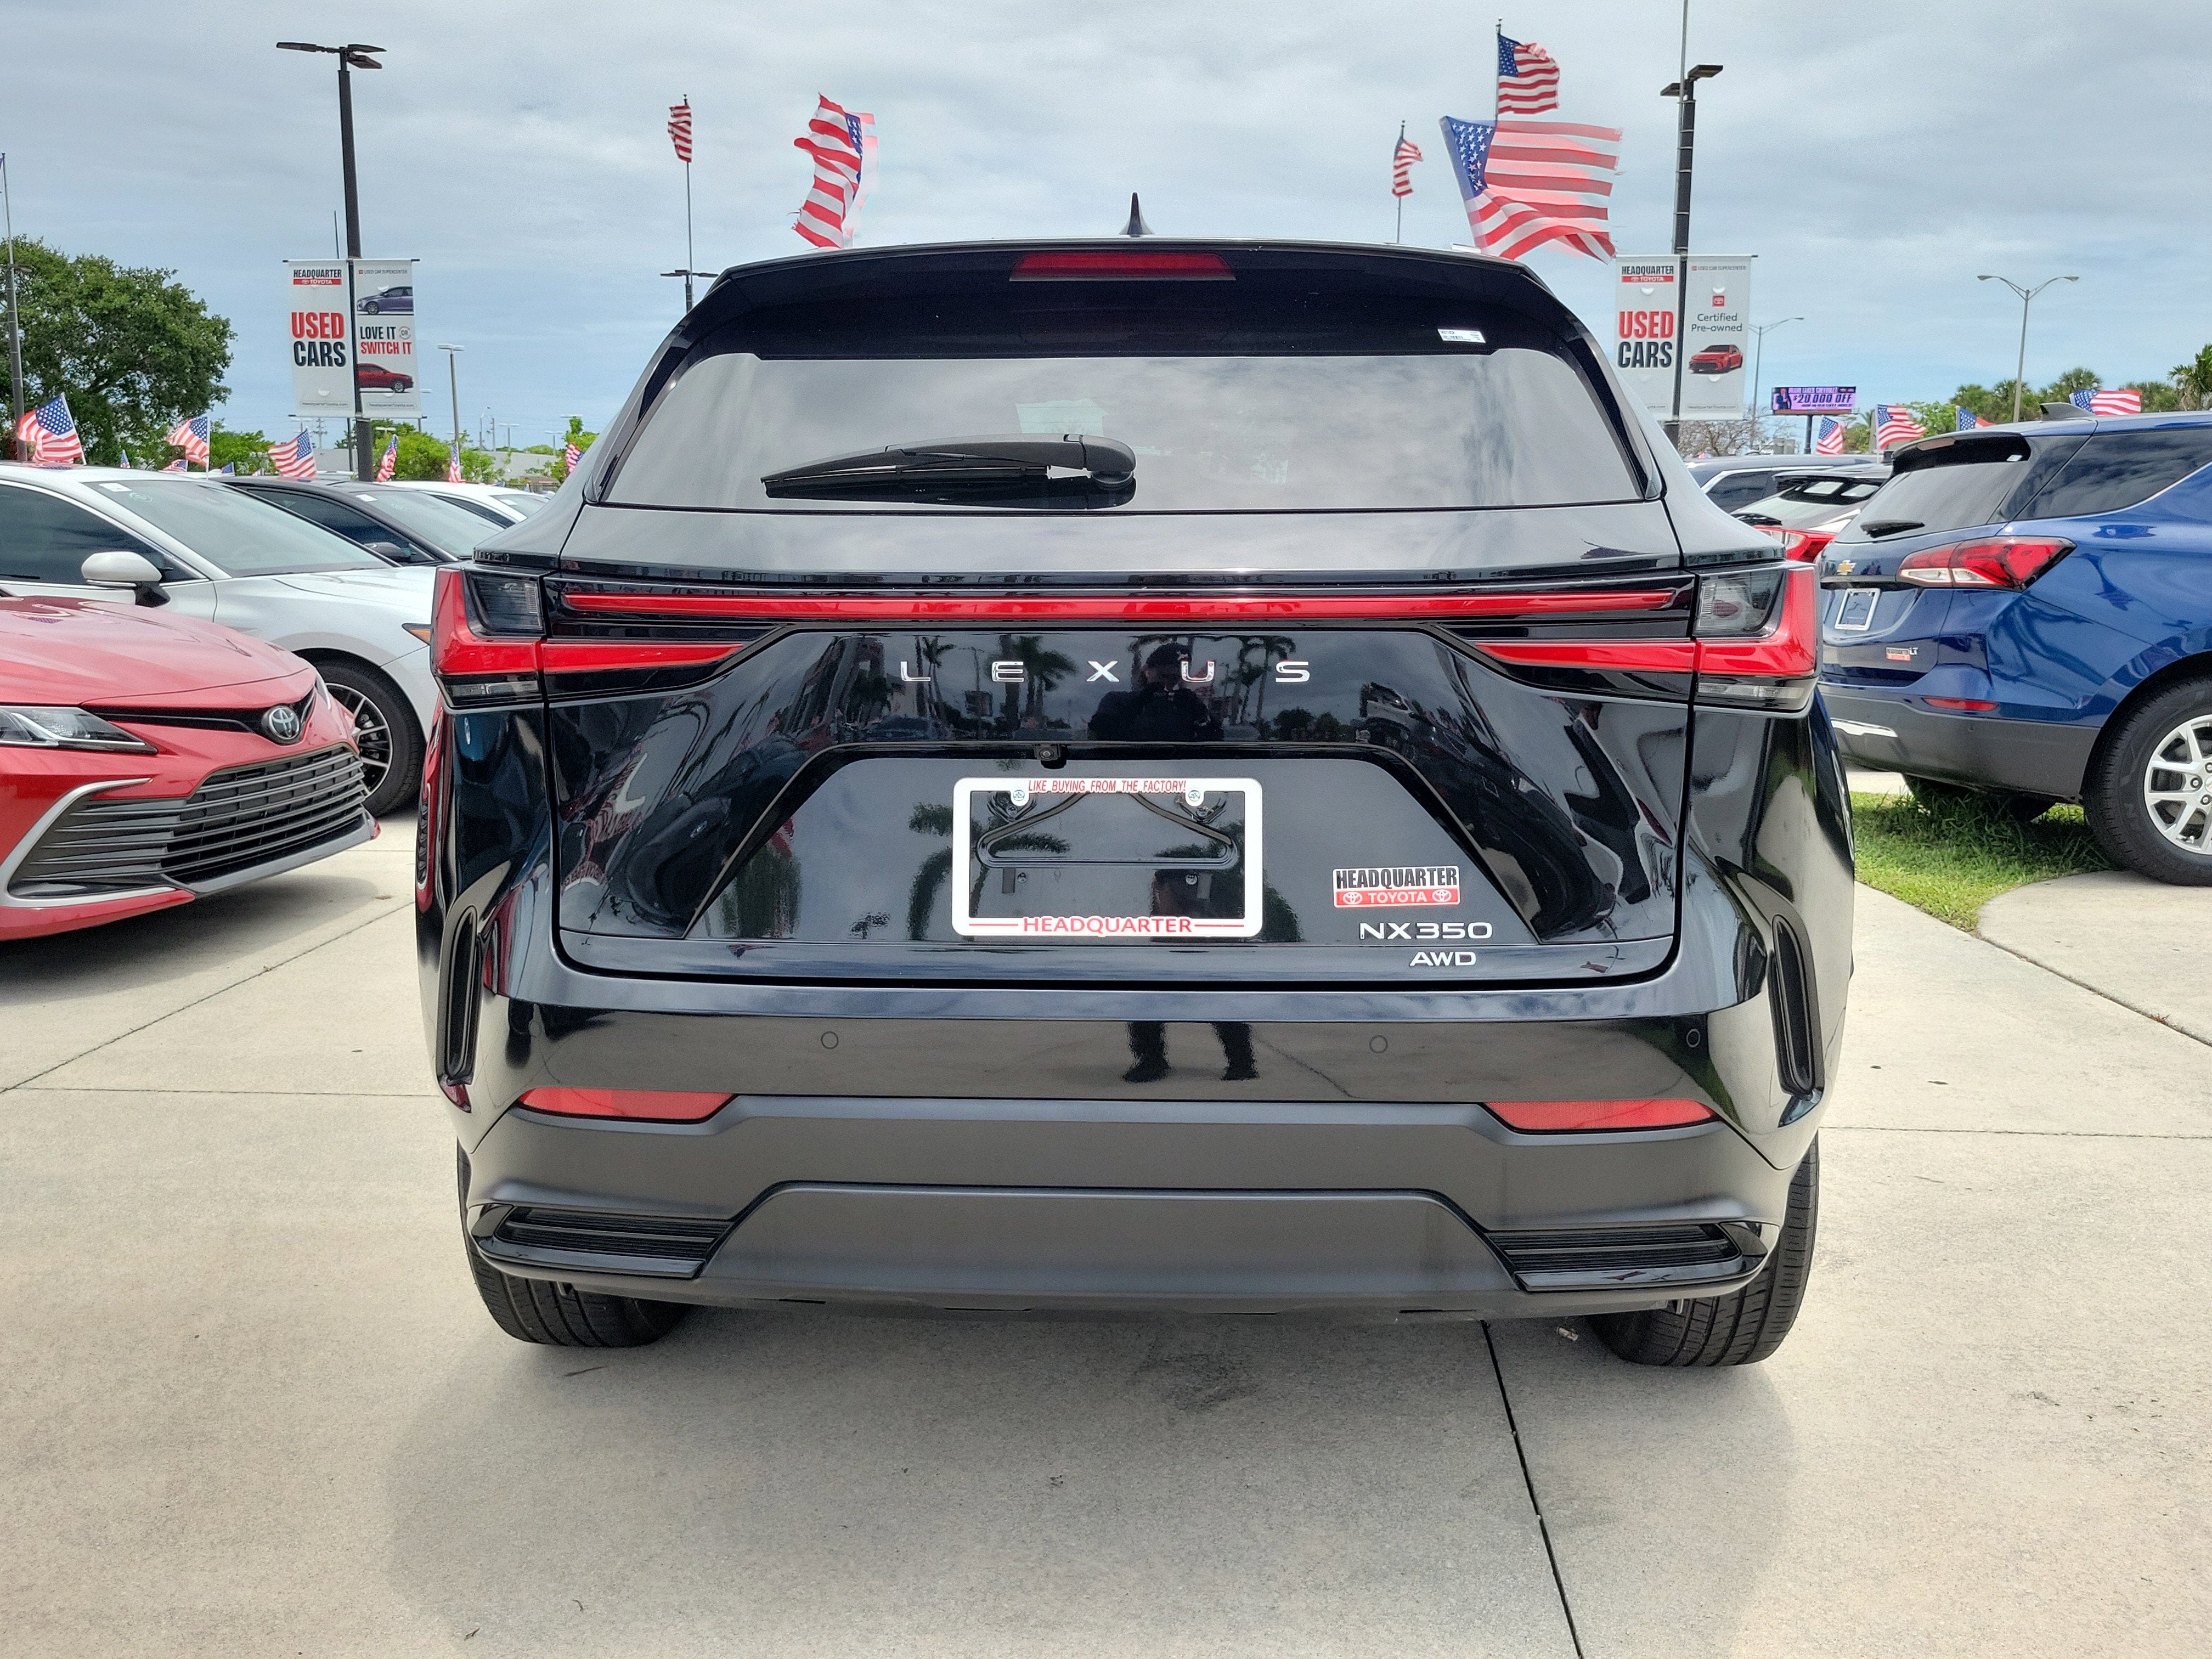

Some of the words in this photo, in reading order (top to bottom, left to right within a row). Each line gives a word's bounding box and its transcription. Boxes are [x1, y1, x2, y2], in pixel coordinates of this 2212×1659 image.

[293, 269, 342, 278] HEADQUARTER
[1621, 266, 1674, 276] HEADQUARTER
[1697, 313, 1737, 322] Certified
[291, 312, 345, 338] USED
[1619, 311, 1674, 338] USED
[1691, 324, 1742, 332] Pre-owned
[360, 327, 383, 340] LOVE
[385, 327, 396, 340] IT
[293, 341, 346, 367] CARS
[360, 342, 399, 354] SWITCH
[403, 342, 412, 354] IT
[1618, 341, 1672, 368] CARS
[1835, 394, 1852, 403] OFF
[900, 661, 1311, 683] LEXUS
[1028, 780, 1047, 792] LIKE
[1052, 780, 1086, 792] BUYING
[1091, 780, 1116, 792] FROM
[1121, 780, 1139, 792] THE
[1143, 780, 1187, 792] FACTORY!
[1336, 867, 1457, 889] HEADQUARTER
[1368, 891, 1427, 903] TOYOTA
[1023, 918, 1192, 933] HEADQUARTER
[1409, 951, 1476, 967] AWD
